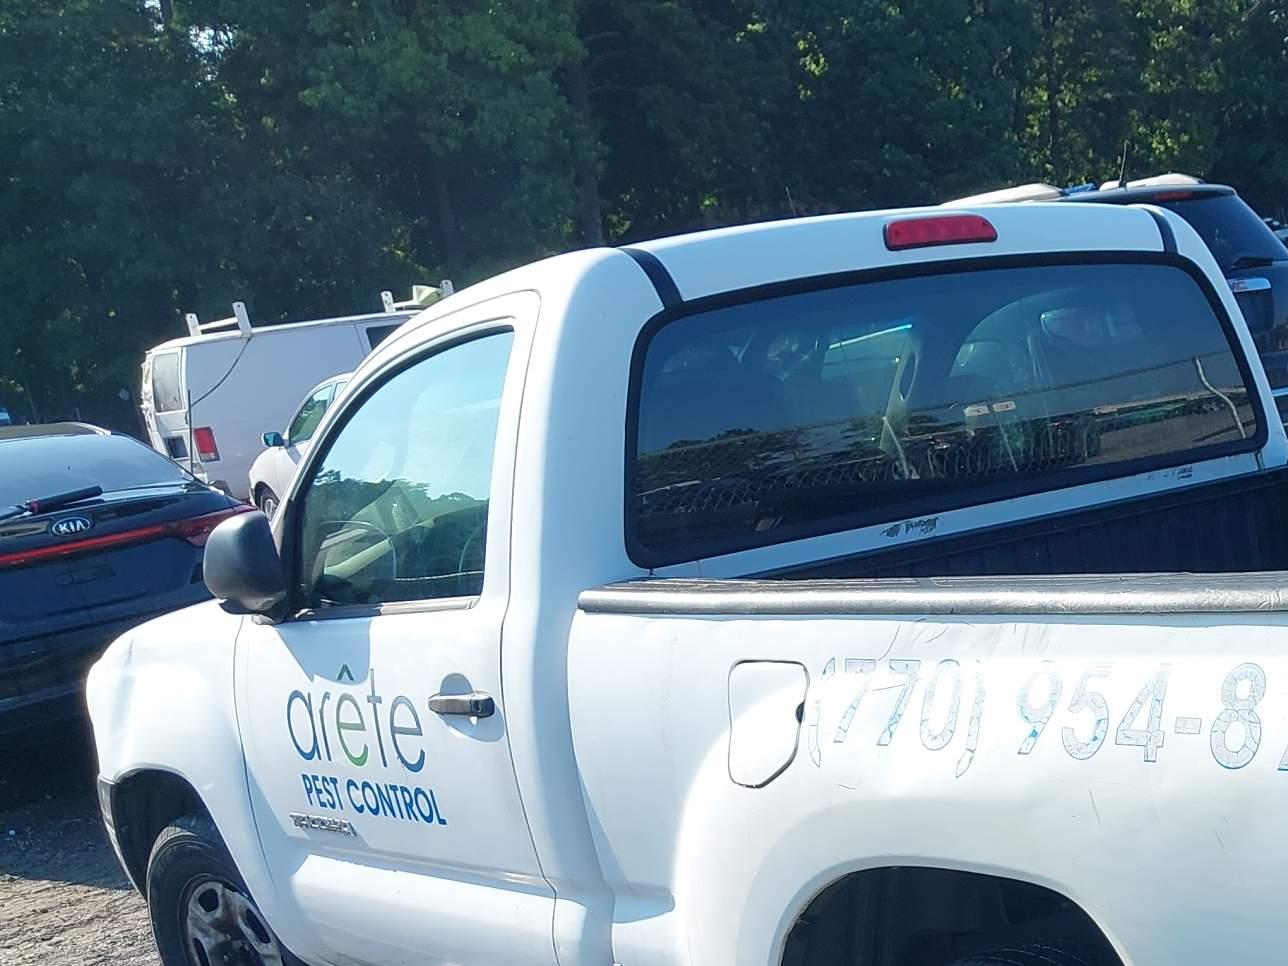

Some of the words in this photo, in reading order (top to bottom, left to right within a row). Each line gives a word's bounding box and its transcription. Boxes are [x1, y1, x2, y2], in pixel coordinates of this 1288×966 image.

[58, 519, 87, 535] KIA
[287, 663, 426, 773] arête
[808, 656, 985, 779] (770)
[302, 773, 344, 811] PEST
[346, 778, 448, 826] CONTROL
